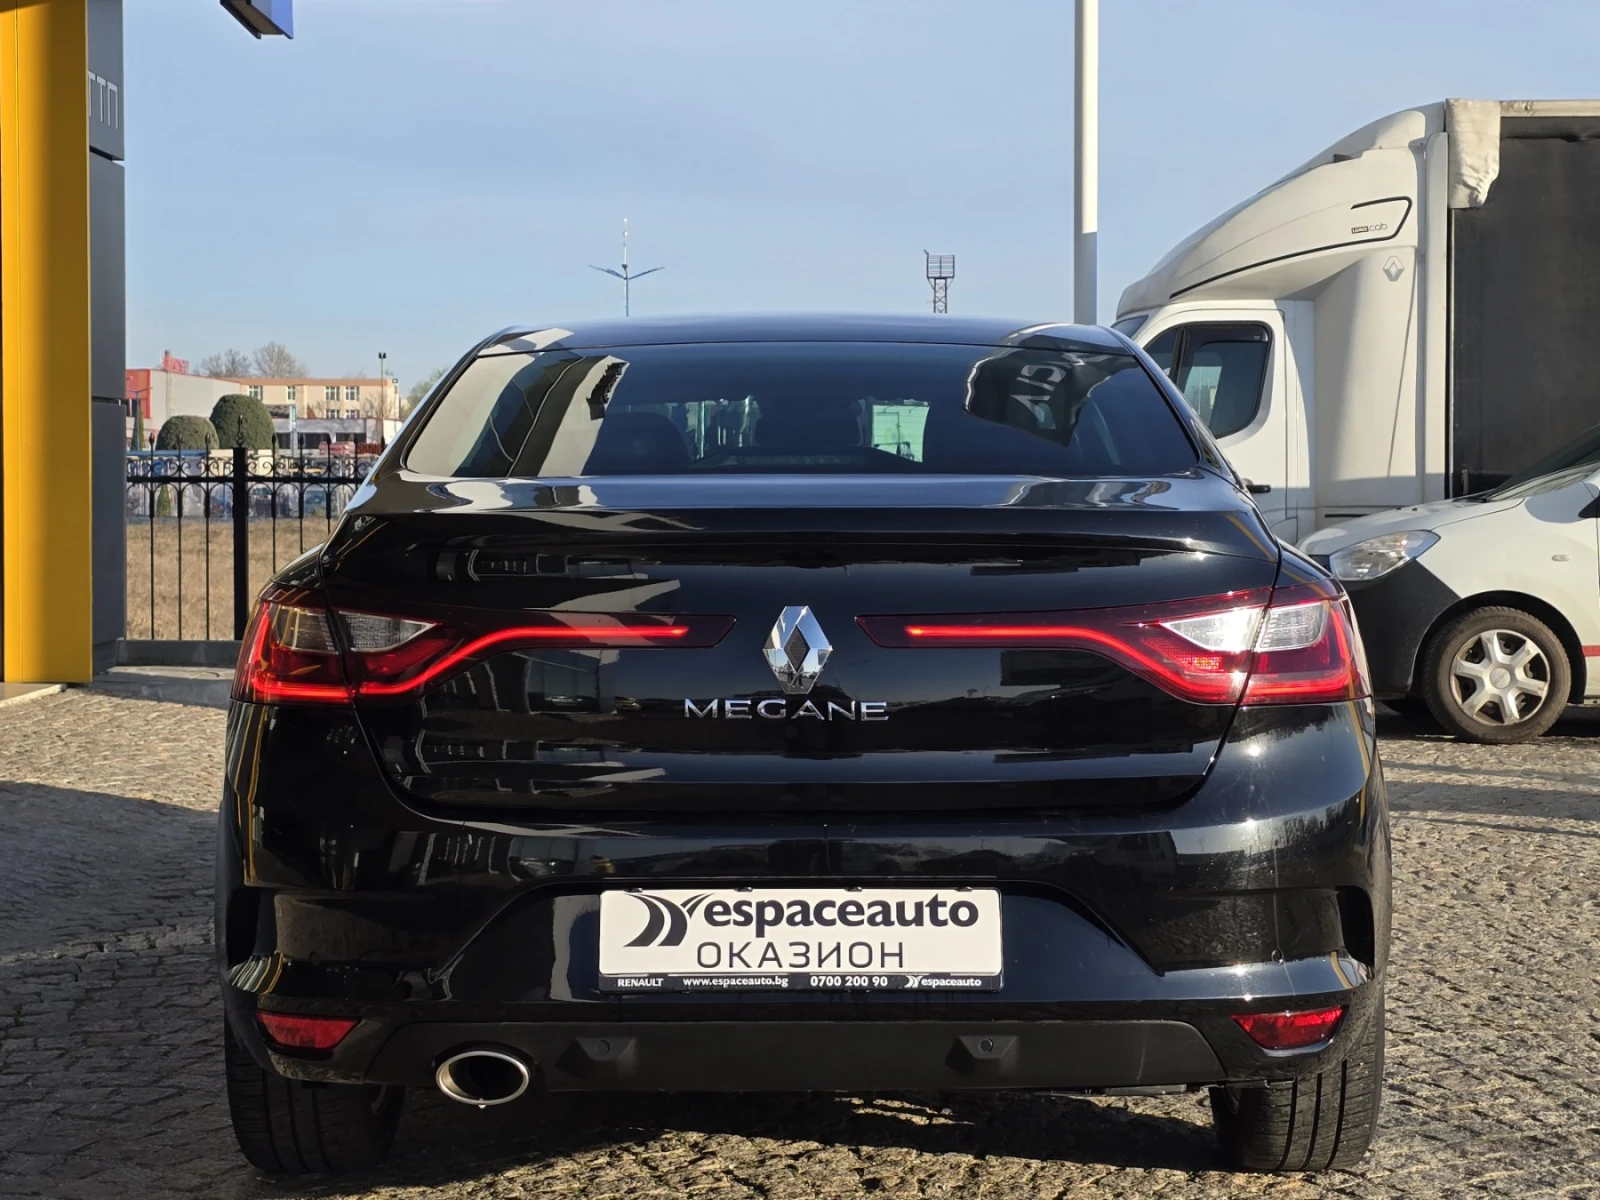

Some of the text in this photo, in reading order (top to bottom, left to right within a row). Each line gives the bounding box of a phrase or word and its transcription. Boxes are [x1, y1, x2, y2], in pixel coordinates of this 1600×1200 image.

[684, 698, 889, 721] MEGANE
[703, 893, 979, 938] espaceauto
[696, 941, 904, 969] ОКАЗИОН
[617, 976, 982, 989] RENAULT www.espaceauto.bg 0700 200 90 espaceauto
